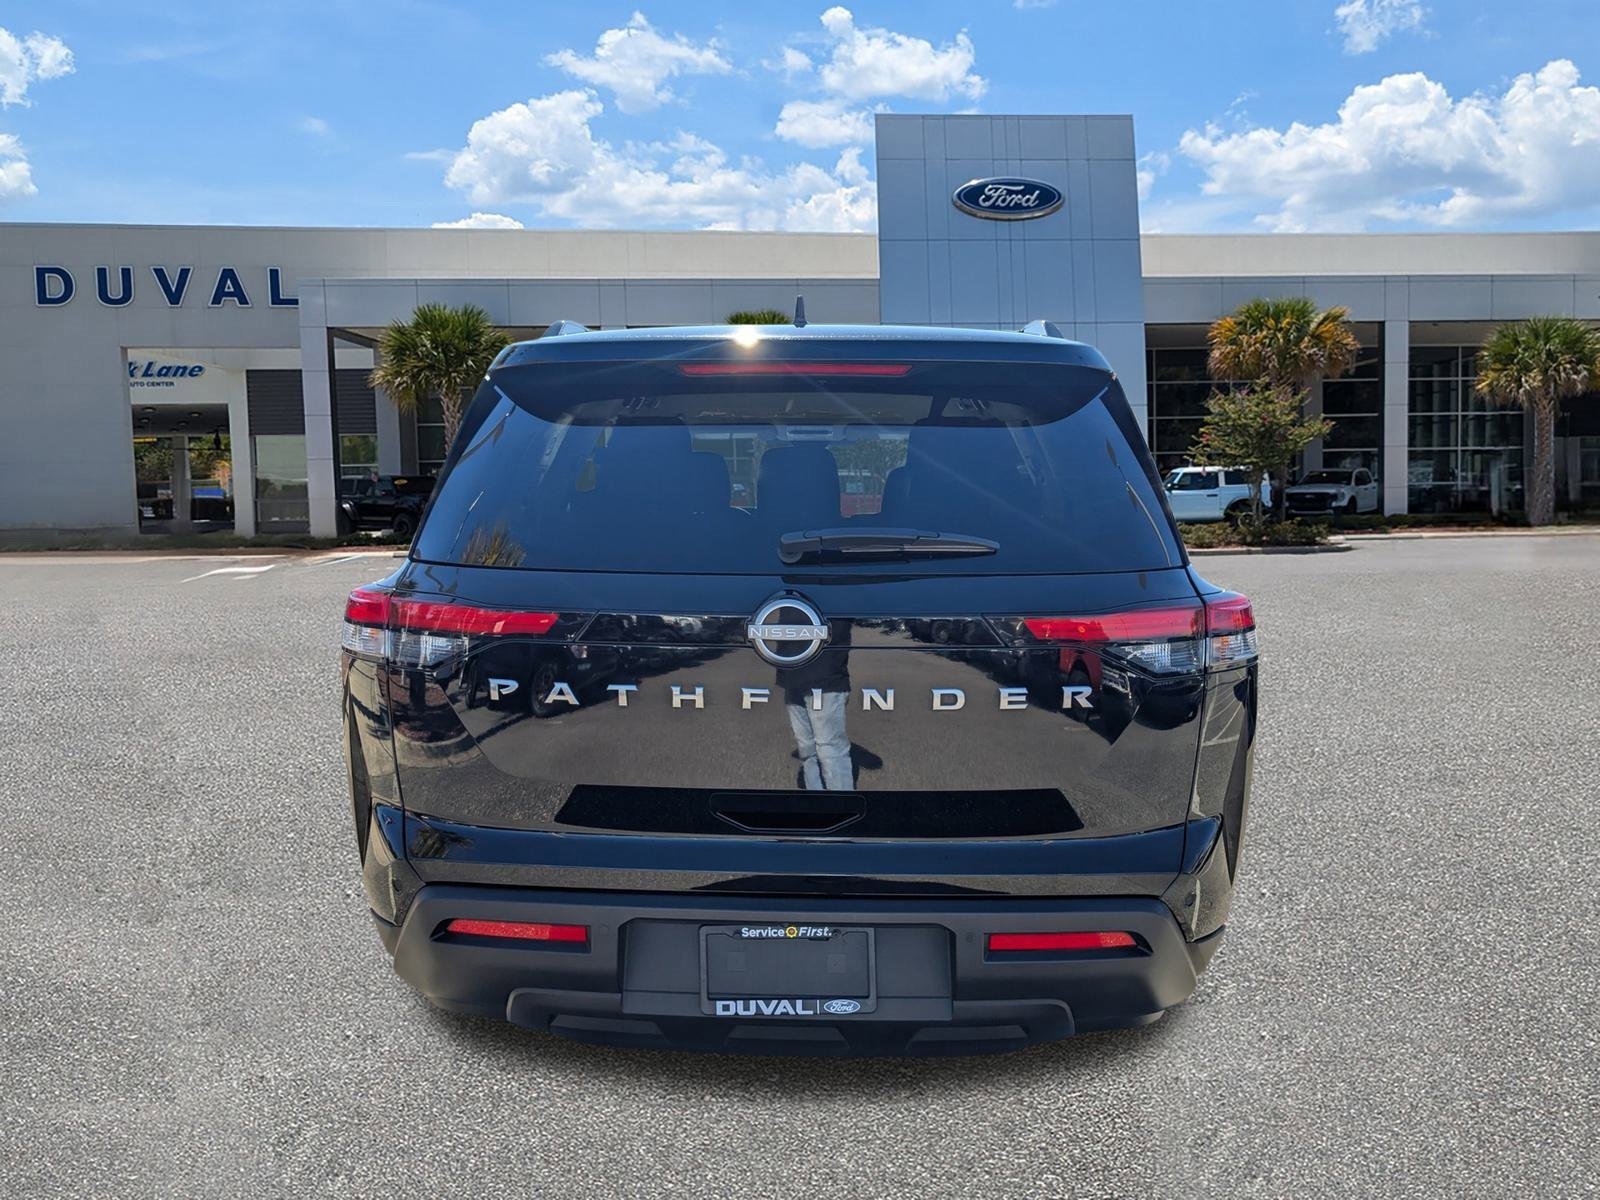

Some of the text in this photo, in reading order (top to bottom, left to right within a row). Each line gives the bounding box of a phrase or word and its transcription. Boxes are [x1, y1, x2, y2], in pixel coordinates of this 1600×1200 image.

[978, 184, 1040, 208] Ford
[33, 265, 300, 307] DUVAL
[141, 361, 205, 378] Lane
[749, 627, 826, 639] NISSAN
[487, 677, 1095, 711] PATHFINDER
[741, 927, 785, 938] Service
[715, 999, 814, 1016] DUVAL
